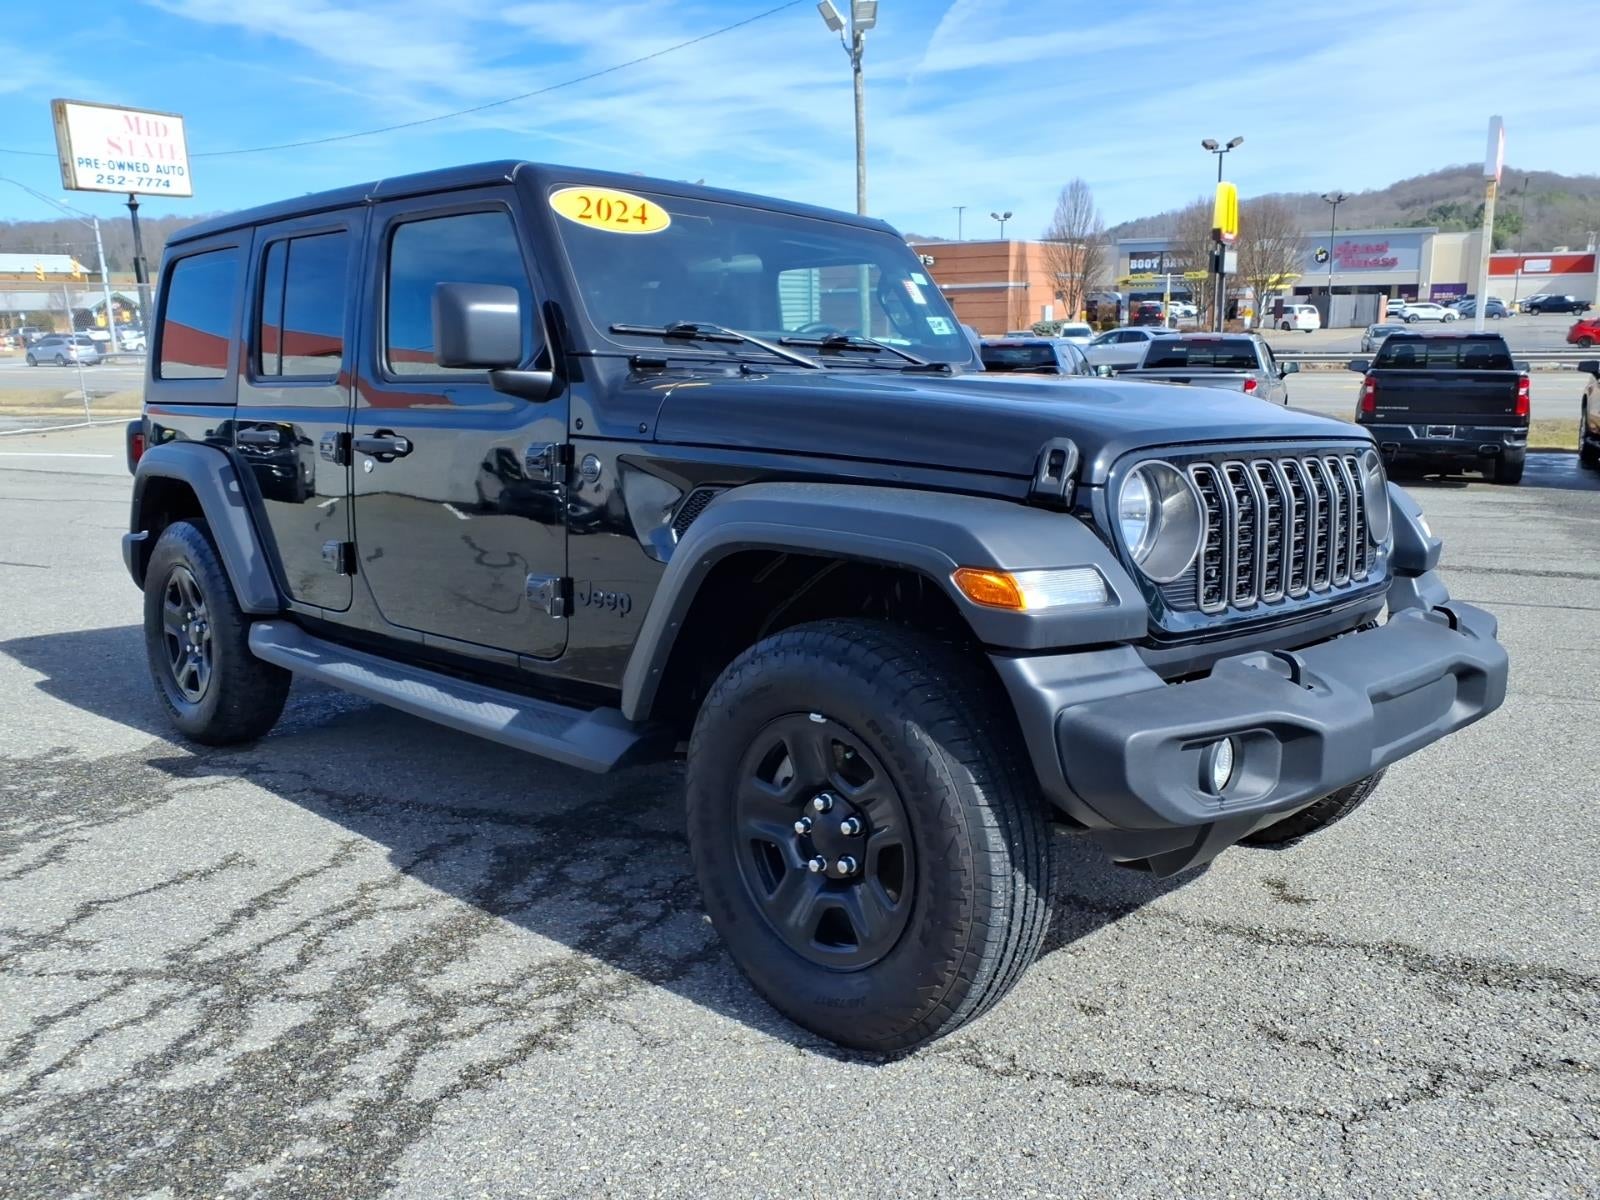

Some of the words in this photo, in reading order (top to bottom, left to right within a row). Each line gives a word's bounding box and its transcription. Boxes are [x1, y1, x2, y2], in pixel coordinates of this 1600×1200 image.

[123, 115, 169, 137] MID
[77, 157, 150, 174] PRE-OWNED
[156, 164, 185, 177] AUTO
[96, 174, 171, 188] 252-7774
[577, 196, 648, 225] 2024
[1130, 259, 1160, 270] BOOT
[580, 577, 632, 618] Jeep
